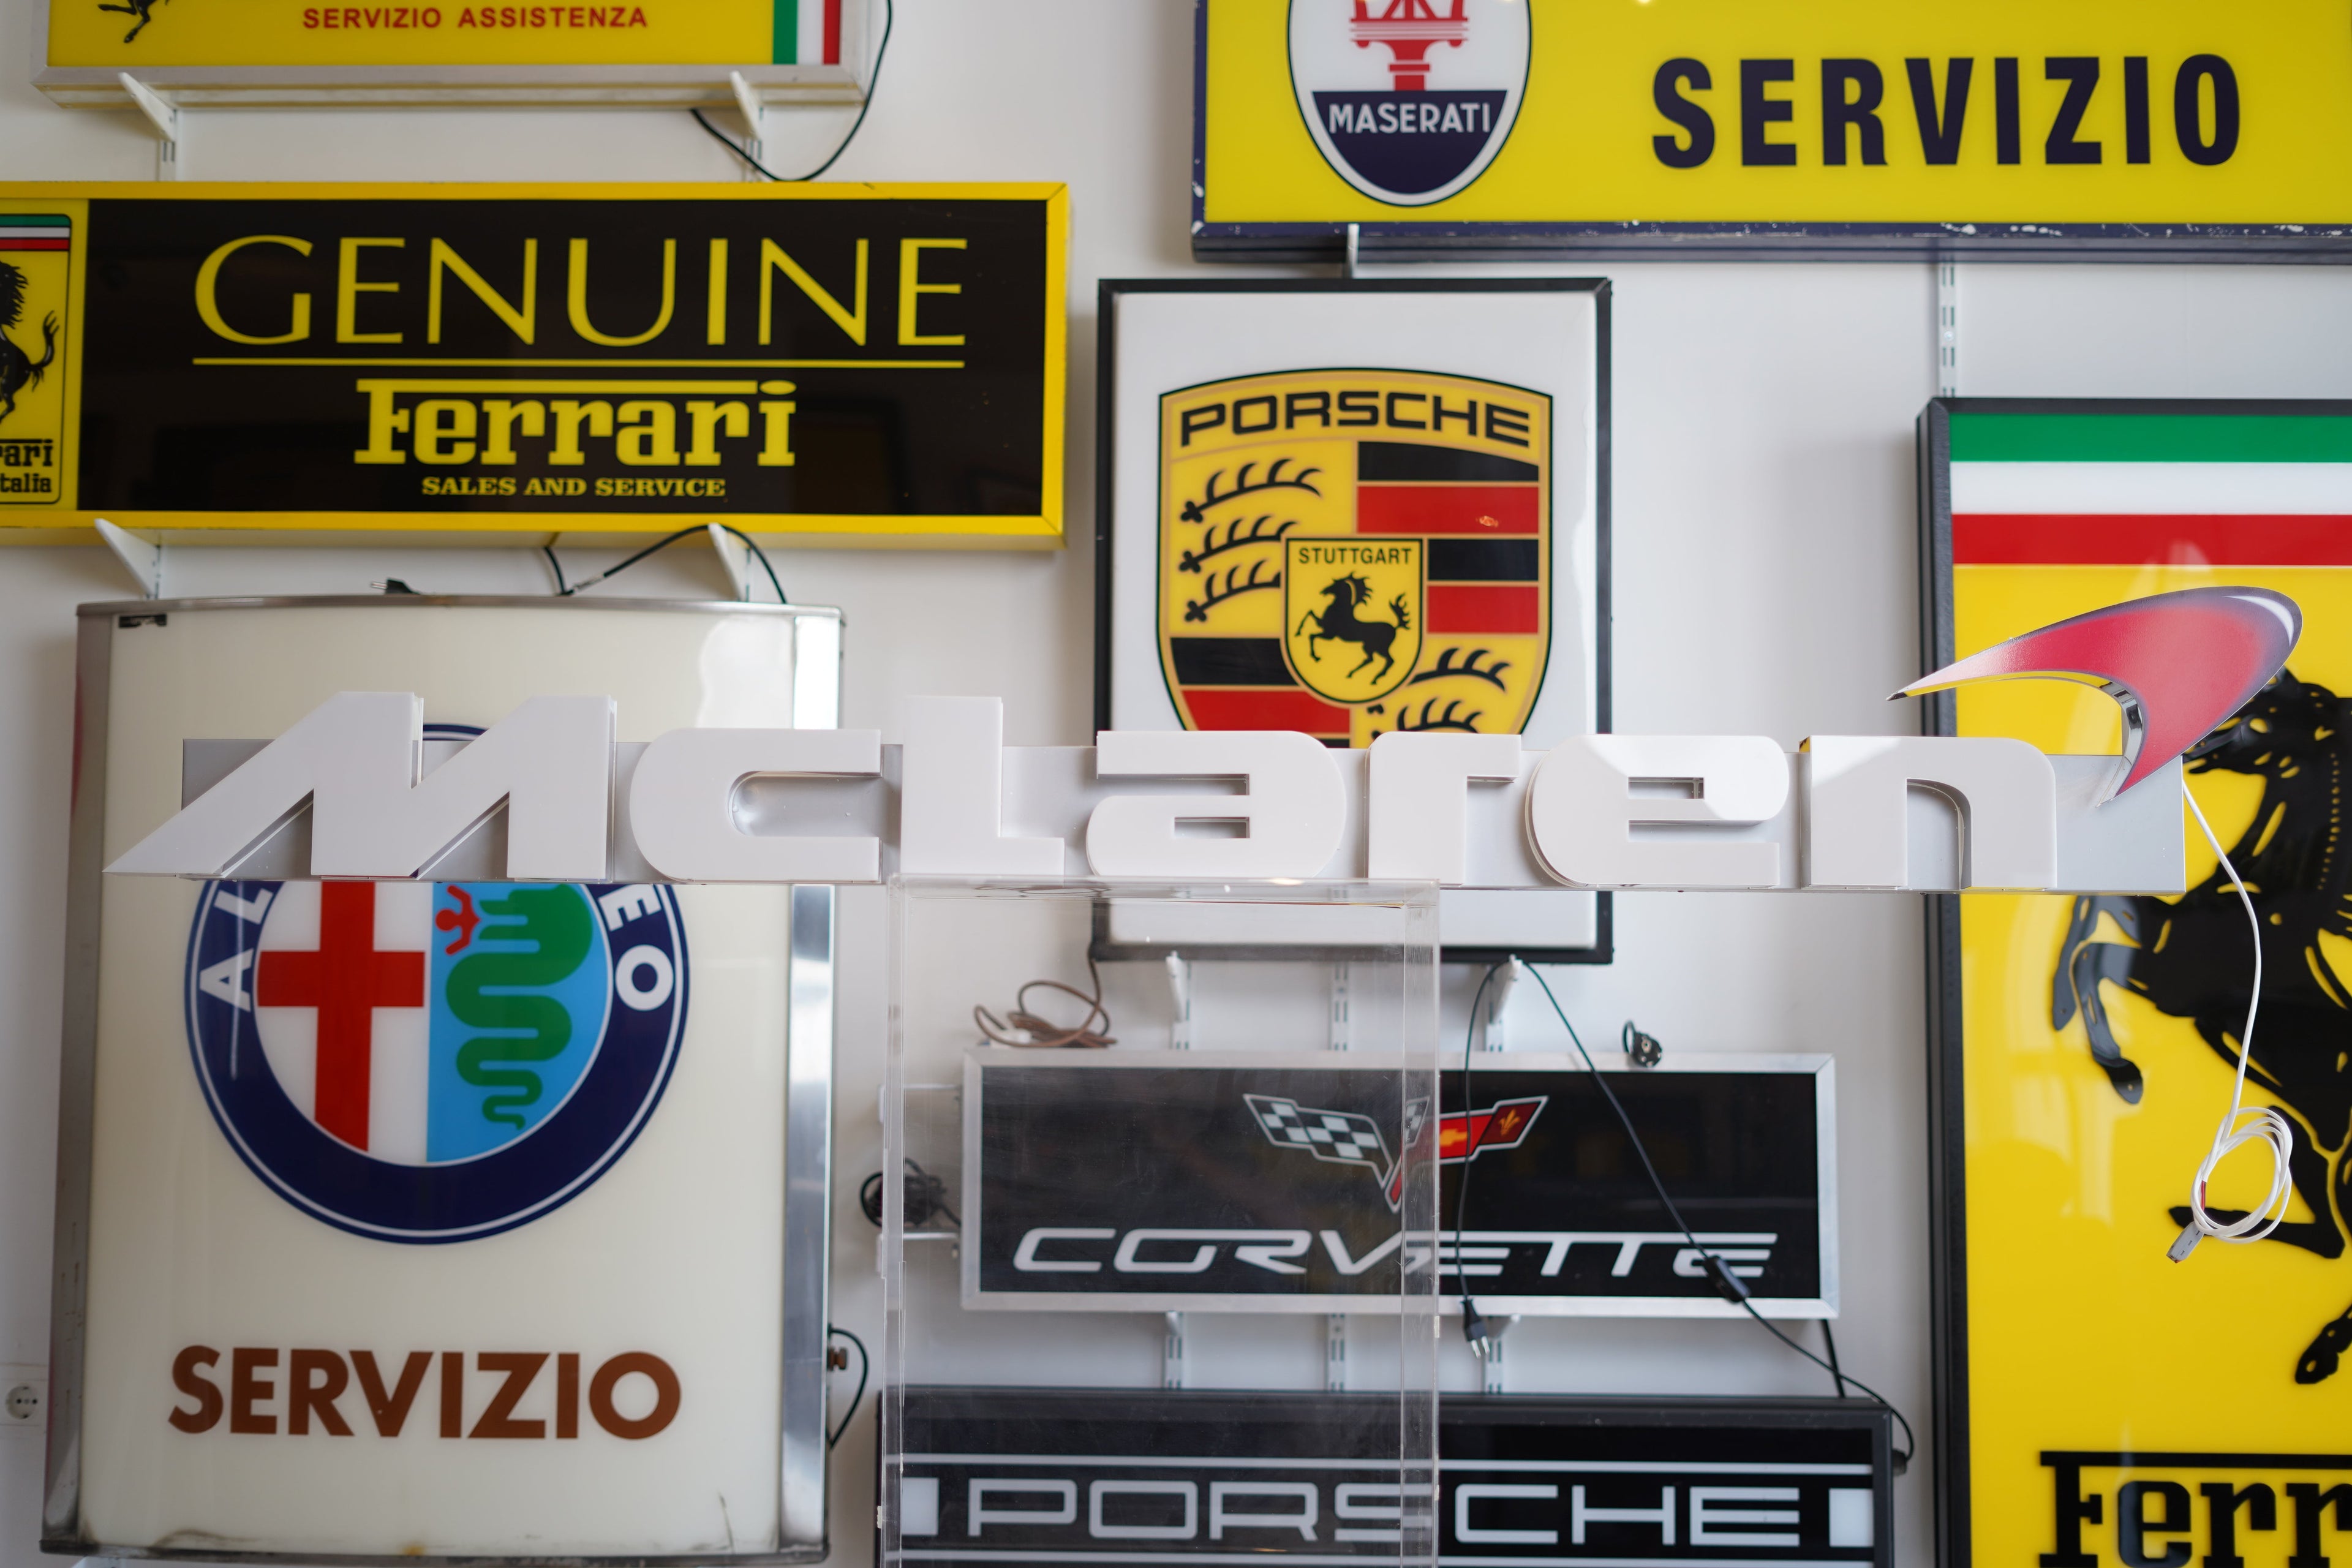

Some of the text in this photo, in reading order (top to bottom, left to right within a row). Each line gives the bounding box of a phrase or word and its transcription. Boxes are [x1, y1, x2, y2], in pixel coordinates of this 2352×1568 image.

[302, 7, 648, 29] SERVIZIO ASSISTENZA
[1328, 102, 1491, 134] MASERATI
[1652, 54, 2241, 169] SERVIZIO
[194, 234, 968, 345] GENUINE
[353, 378, 797, 466] Ferrari
[1180, 390, 1530, 449] PORSCHE
[421, 477, 726, 497] SALES AND SERVICE
[1298, 548, 1412, 564] STUTTGART
[199, 886, 274, 1012] AL
[1012, 1227, 1778, 1277] CORVETTE
[168, 1344, 682, 1441] SERVIZIO
[968, 1477, 1800, 1545] PORSCHE
